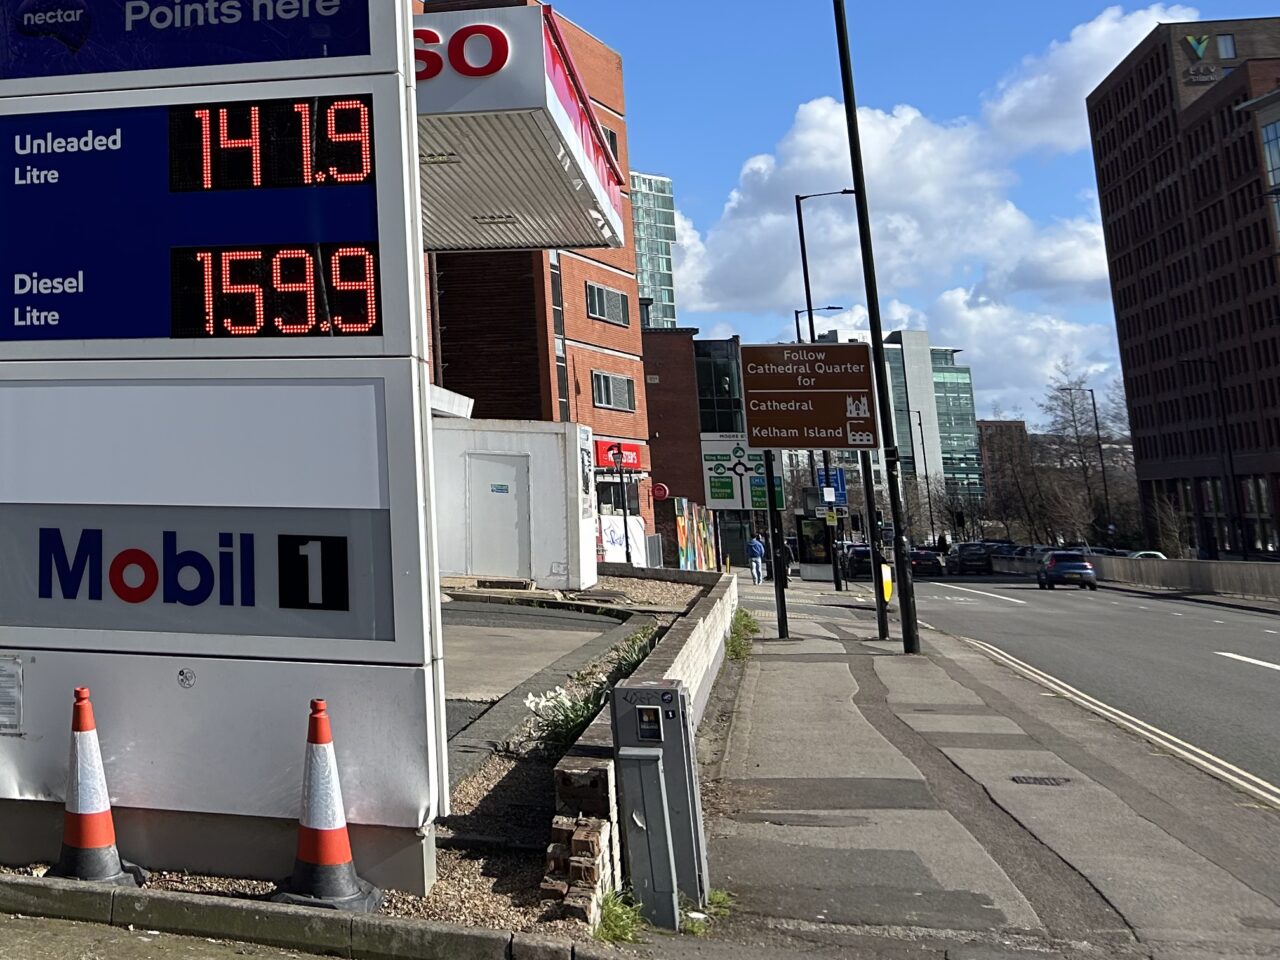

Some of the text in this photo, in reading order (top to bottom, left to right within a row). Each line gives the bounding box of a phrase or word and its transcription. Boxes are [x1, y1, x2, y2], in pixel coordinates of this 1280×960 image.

[23, 6, 84, 26] nectar
[15, 99, 372, 189] Unleaded 141.9
[14, 167, 59, 186] Litre
[14, 247, 377, 336] Diesel 159.9
[14, 307, 60, 327] Litre
[784, 350, 826, 360] Follow
[747, 362, 865, 374] Cathedral Quarter
[797, 376, 816, 386] for
[749, 400, 814, 411] Cathedral
[752, 427, 843, 437] Kelham Island
[38, 526, 256, 607] Mobil
[298, 540, 324, 604] 1
